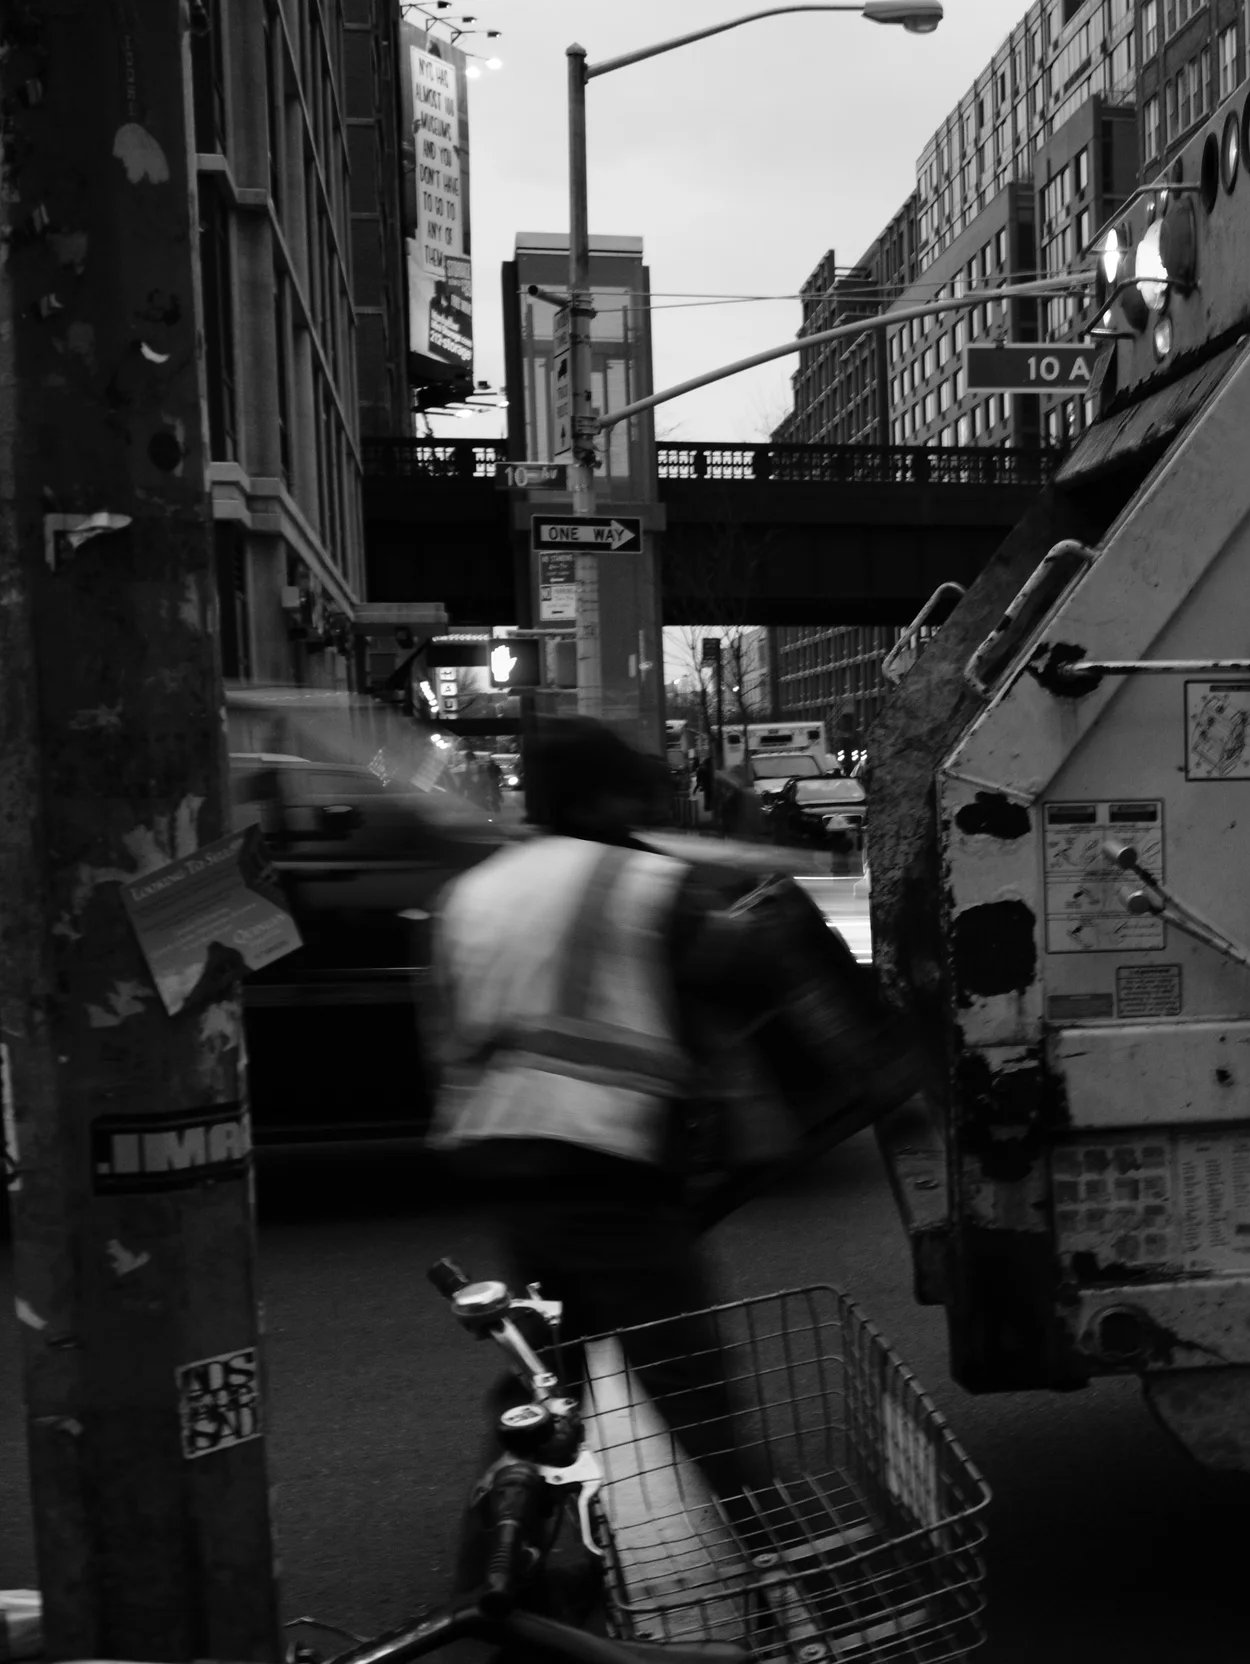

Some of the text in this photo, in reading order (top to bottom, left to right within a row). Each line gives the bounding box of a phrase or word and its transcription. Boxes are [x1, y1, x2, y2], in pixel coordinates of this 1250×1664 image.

[422, 190, 433, 213] TO
[445, 200, 456, 221] TO
[1027, 355, 1060, 381] 10
[548, 526, 626, 542] ONE WAY
